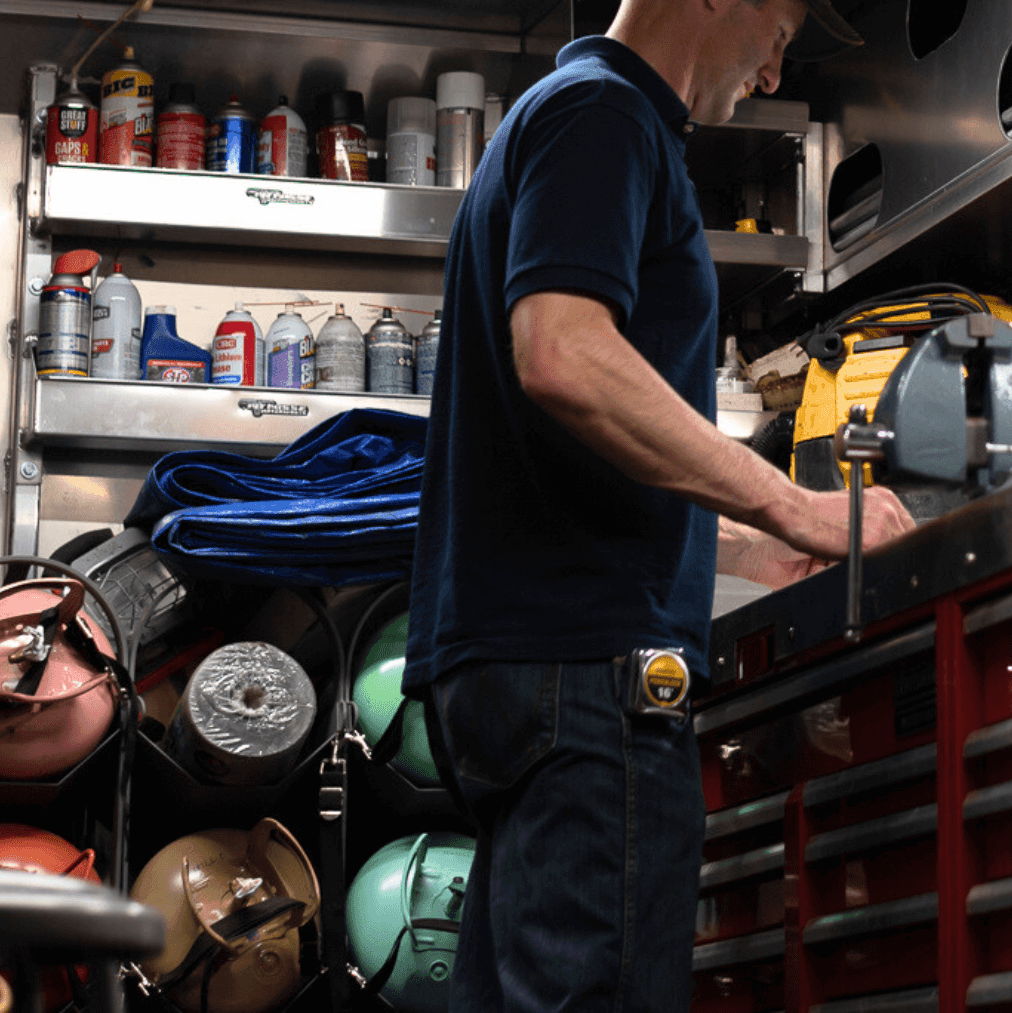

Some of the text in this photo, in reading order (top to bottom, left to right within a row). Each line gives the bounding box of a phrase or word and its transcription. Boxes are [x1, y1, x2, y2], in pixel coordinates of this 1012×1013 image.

[61, 110, 86, 119] GREAT
[61, 120, 85, 130] STUFF
[55, 141, 89, 156] GAPS &
[165, 368, 188, 383] STP
